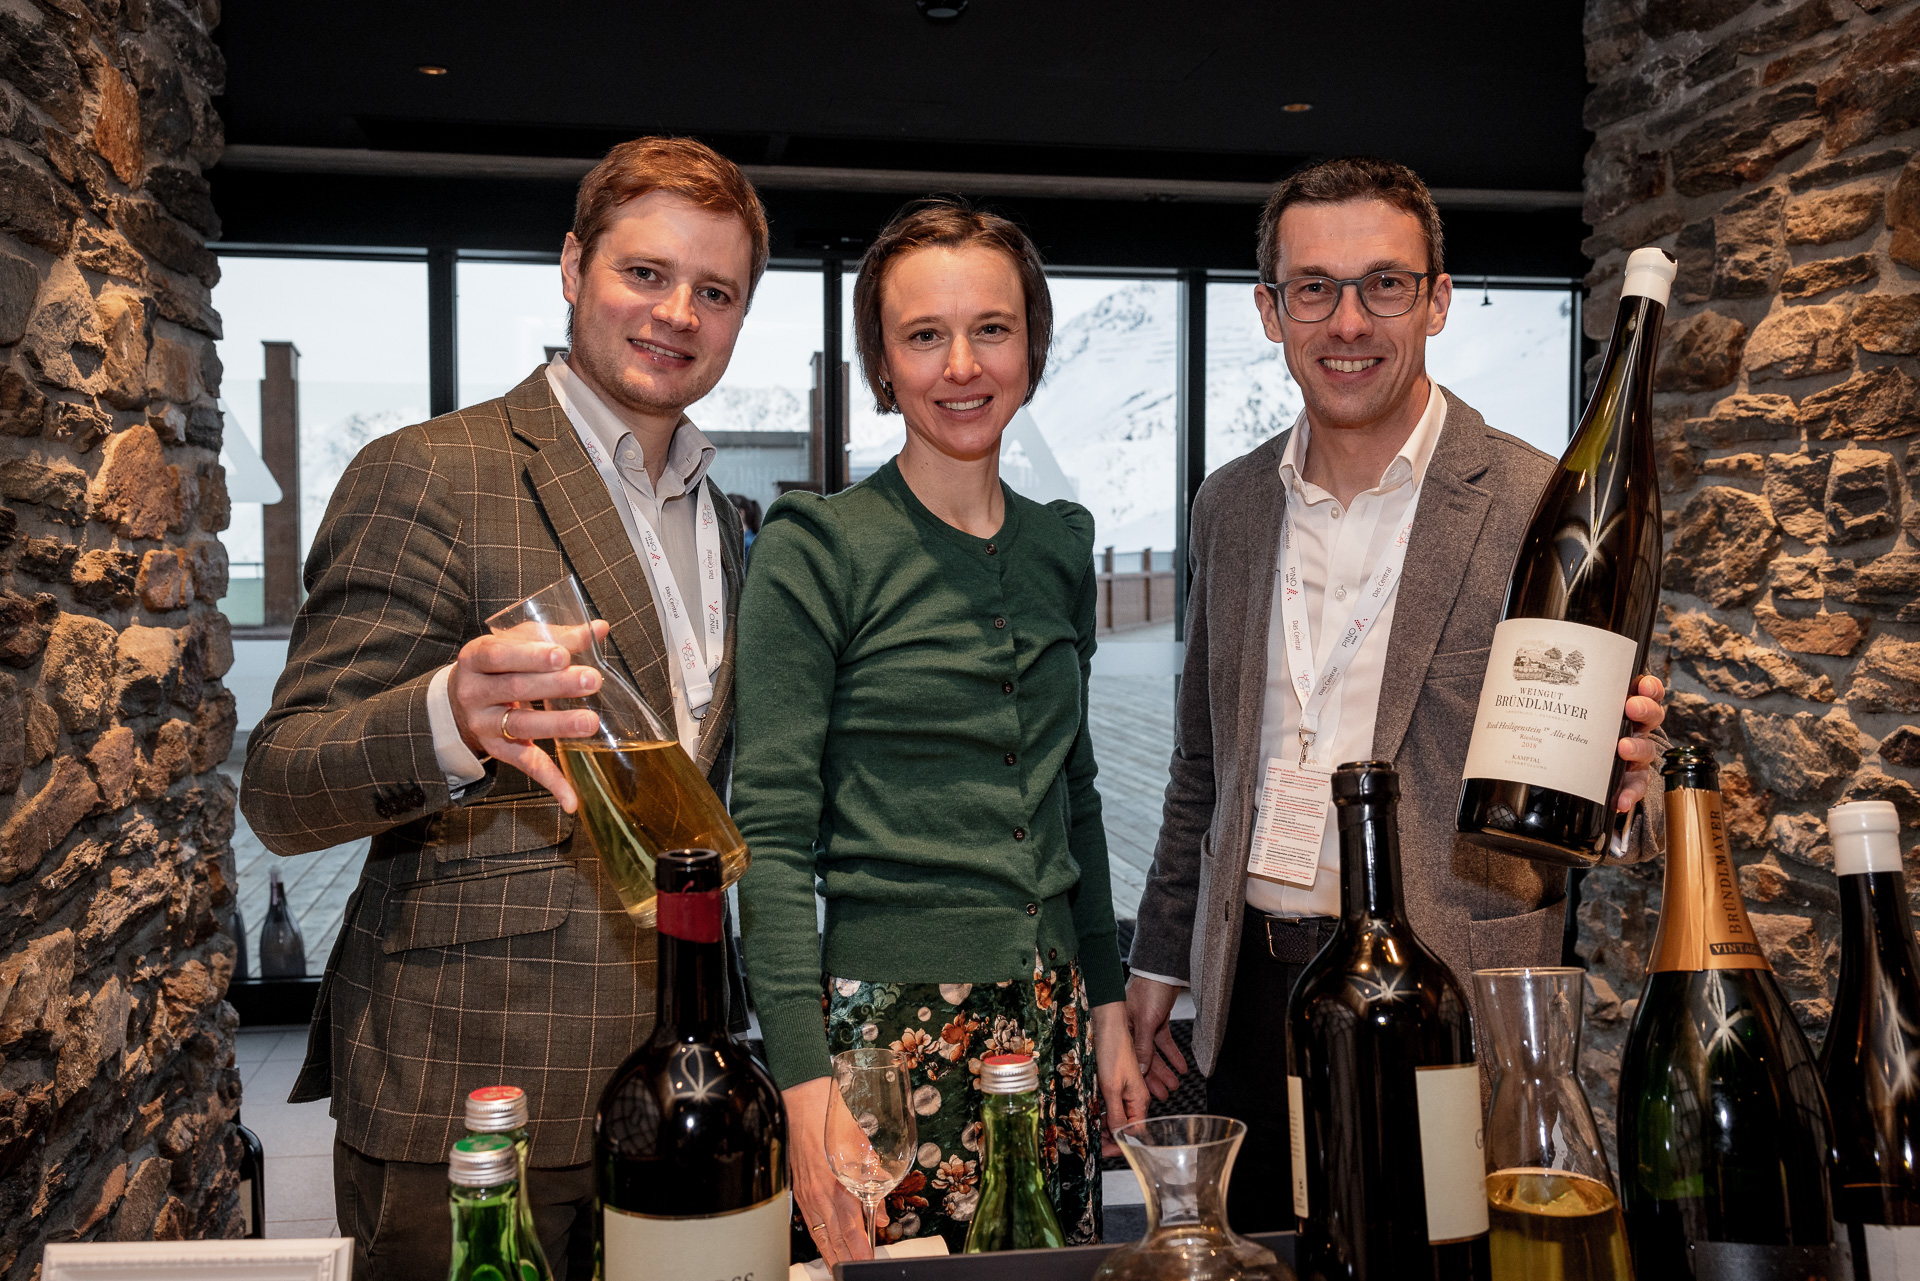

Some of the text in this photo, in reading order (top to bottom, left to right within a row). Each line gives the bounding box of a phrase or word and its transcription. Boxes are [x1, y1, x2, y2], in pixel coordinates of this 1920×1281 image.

[1372, 587, 1382, 598] Das
[1378, 567, 1393, 588] Central
[1293, 631, 1302, 651] Central
[1342, 627, 1357, 648] PINO
[1324, 666, 1338, 686] Central
[1520, 687, 1563, 700] WEINGUT
[1495, 694, 1588, 720] BRÜNDLMAYER
[1486, 721, 1499, 729] Ried
[1499, 721, 1542, 734] Heiligenstein
[1550, 730, 1565, 739] Alte
[1567, 733, 1588, 744] Reben
[1519, 733, 1543, 744] Riesling
[1521, 741, 1537, 750] 2018
[1512, 754, 1541, 763] KAMPTAL
[1709, 810, 1743, 935] BRÜNDLMAYER
